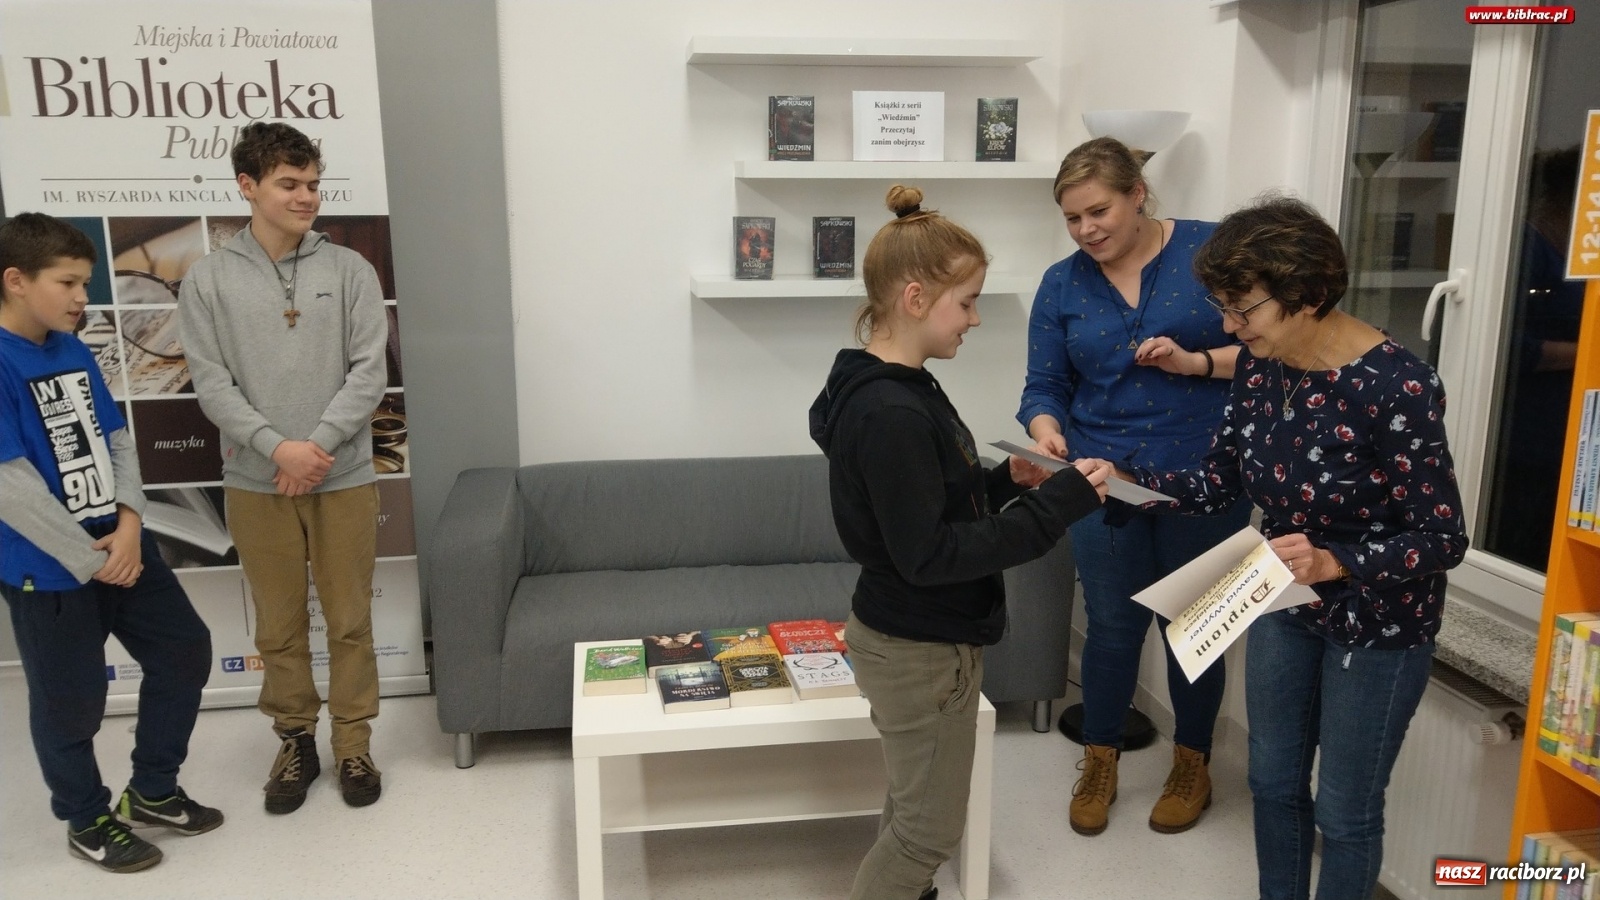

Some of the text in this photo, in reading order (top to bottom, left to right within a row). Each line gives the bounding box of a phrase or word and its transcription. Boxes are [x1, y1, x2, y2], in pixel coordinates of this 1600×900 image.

[133, 25, 338, 53] Miejska i Powiatowa
[23, 56, 344, 119] Biblioteka
[874, 101, 900, 110] Książki
[907, 101, 922, 109] serii
[880, 126, 916, 135] Przeczytaj
[893, 139, 925, 147] obejrzysz
[43, 190, 69, 203] IM.
[77, 190, 162, 203] RYSZARDA
[169, 190, 232, 202] KINCLA
[154, 436, 205, 451] muzyka
[1226, 569, 1259, 603] Dawid
[1183, 600, 1216, 632] miejsca
[1189, 604, 1226, 642] Wypler
[1195, 577, 1276, 657] Dyplom
